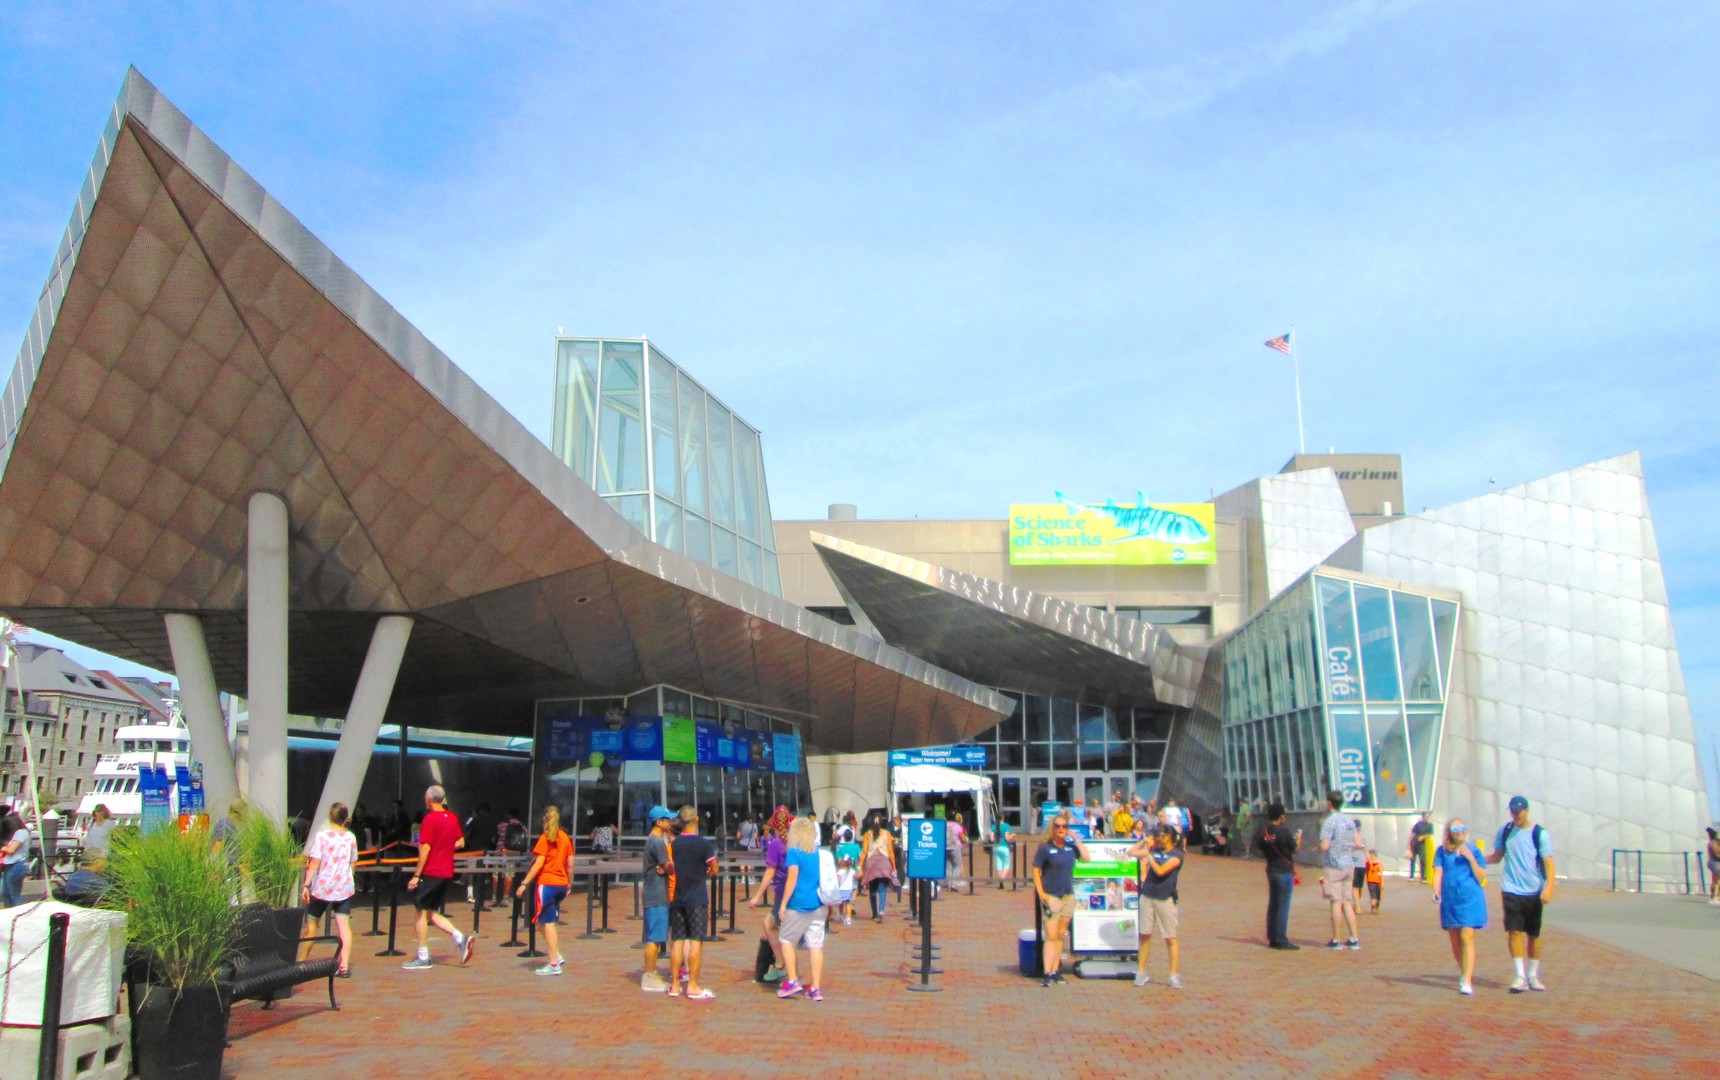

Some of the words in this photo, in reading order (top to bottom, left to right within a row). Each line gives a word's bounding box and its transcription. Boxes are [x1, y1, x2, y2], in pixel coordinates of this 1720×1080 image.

[1014, 515, 1086, 530] Science
[1014, 532, 1032, 547] of
[1036, 532, 1102, 547] Sharks
[1328, 646, 1357, 696] Café
[1339, 748, 1366, 802] Gifts
[922, 834, 933, 842] Buy
